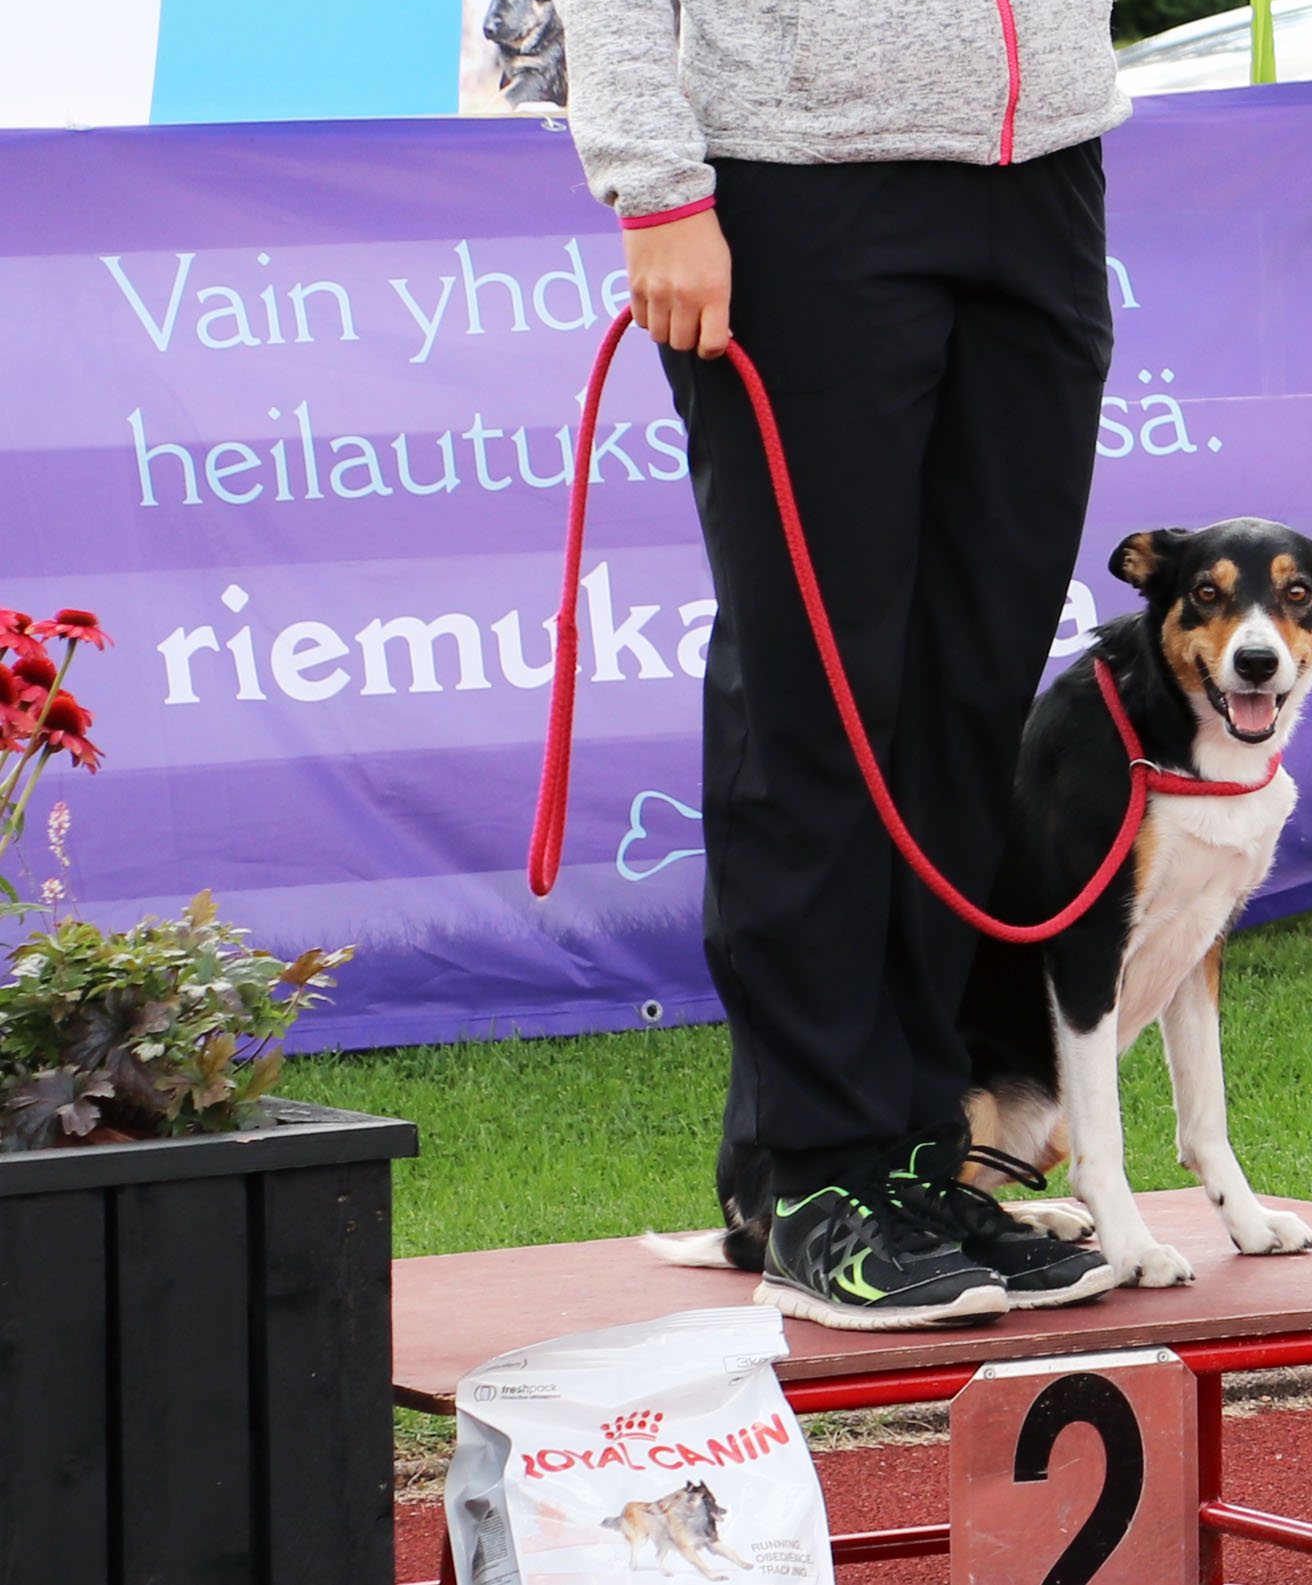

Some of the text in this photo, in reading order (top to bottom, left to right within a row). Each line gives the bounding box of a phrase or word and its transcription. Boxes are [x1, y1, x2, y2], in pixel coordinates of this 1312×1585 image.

[101, 236, 635, 363] Vain yhde
[127, 369, 1223, 506] heilautuks sä.
[156, 561, 719, 704] riemuka
[501, 1382, 558, 1396] freshpack
[649, 1413, 791, 1469] CANIN
[1013, 1372, 1145, 1585] 2
